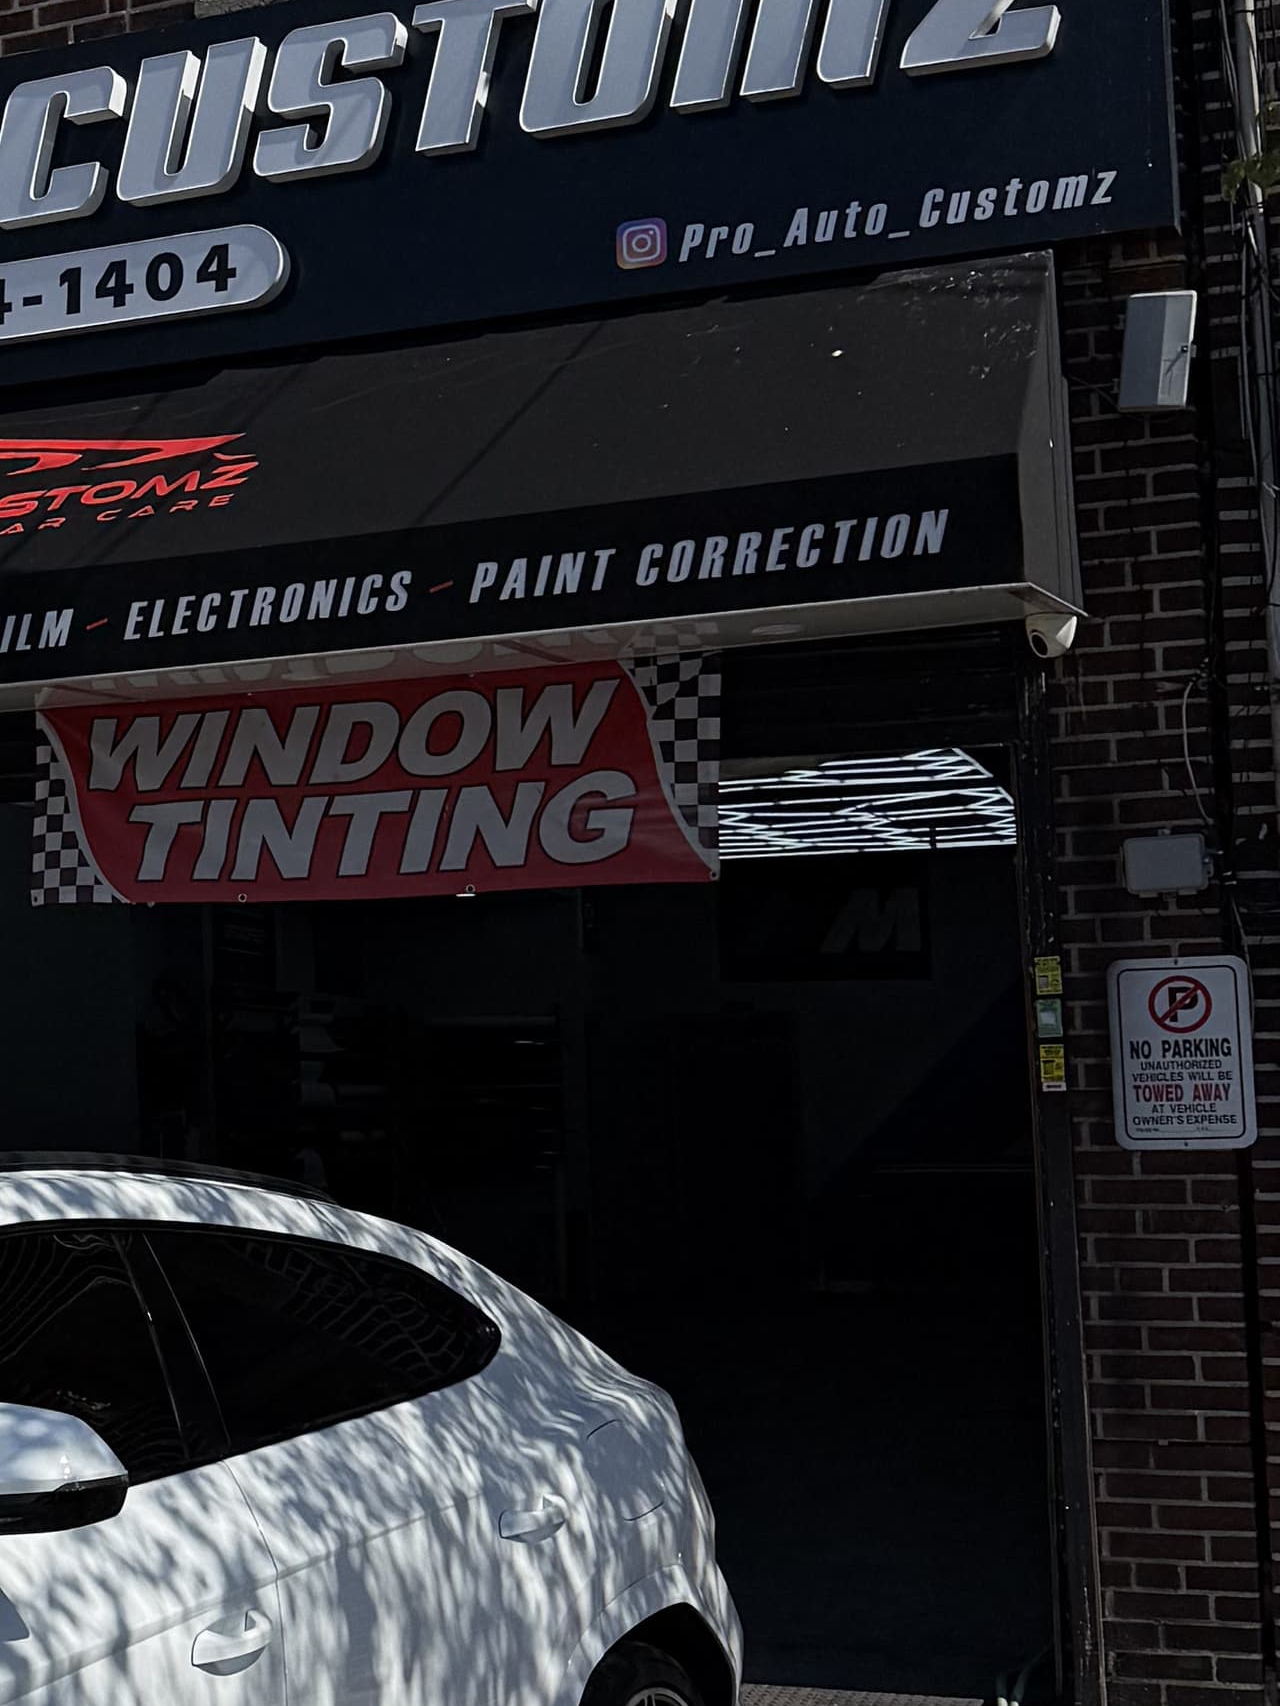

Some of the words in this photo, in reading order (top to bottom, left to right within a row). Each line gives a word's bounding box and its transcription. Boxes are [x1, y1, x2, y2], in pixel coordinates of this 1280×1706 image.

[678, 170, 1118, 263] Pro_Auto_Customz
[96, 494, 237, 522] CARE
[123, 569, 413, 641] ELECTRONICS
[469, 547, 616, 605] PAINT
[636, 508, 950, 587] CORRECTION
[86, 677, 622, 793] WINDOW
[128, 769, 637, 882] TINTING
[1130, 1040, 1152, 1059] NO
[1161, 1038, 1231, 1058] PARKING
[1140, 1059, 1222, 1071] UNAUTHORIZED
[1132, 1072, 1184, 1082] VEHICLES
[1189, 1071, 1214, 1081] WILL
[1218, 1070, 1233, 1081] BE
[1133, 1084, 1184, 1102] TOWED
[1192, 1083, 1231, 1101] AWAY
[1152, 1104, 1165, 1113] AT
[1170, 1103, 1217, 1113] VEHICLE
[1132, 1115, 1184, 1125] OWNER'S
[1186, 1114, 1237, 1124] EXPENSE
